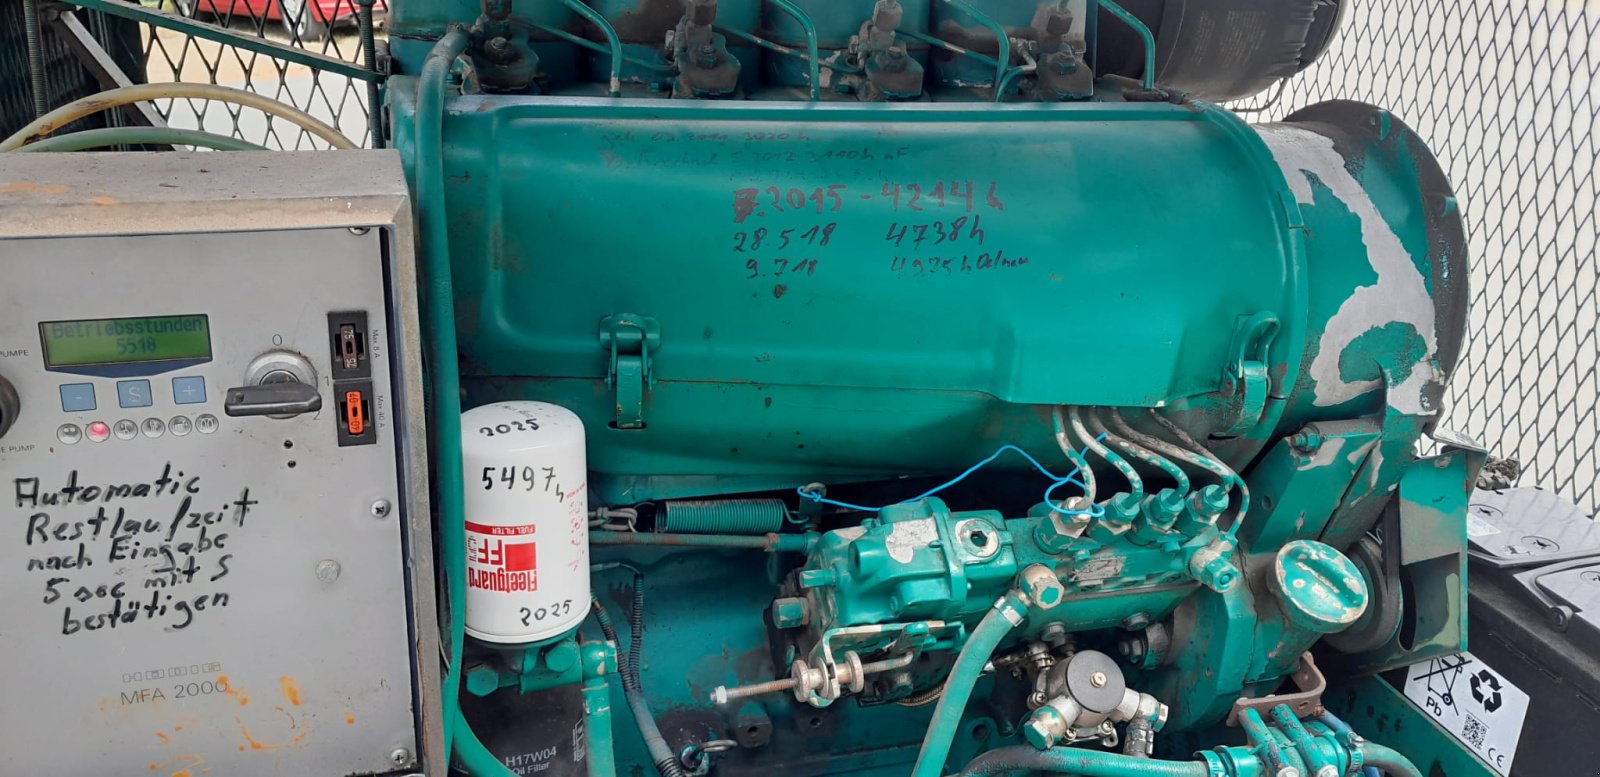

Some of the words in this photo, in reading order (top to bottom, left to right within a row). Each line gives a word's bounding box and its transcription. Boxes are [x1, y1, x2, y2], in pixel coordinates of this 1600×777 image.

[881, 180, 974, 212] 4214
[52, 317, 203, 339] Betriebsstunden
[116, 338, 157, 355] 5518
[480, 418, 539, 437] 2025
[9, 444, 35, 453] PUMP
[14, 461, 201, 508] Automatic
[516, 526, 534, 534] FUEL
[28, 543, 93, 571] nach
[109, 526, 229, 574] Eingabe
[43, 578, 70, 604] 5
[144, 555, 201, 588] mit
[468, 566, 538, 593] Fleetguard
[62, 591, 229, 635] bestätigen
[519, 599, 572, 626] 2025
[120, 688, 166, 705] MFA
[174, 680, 228, 698] 2000
[1426, 696, 1442, 717] Pb
[505, 746, 557, 766] H17W04
